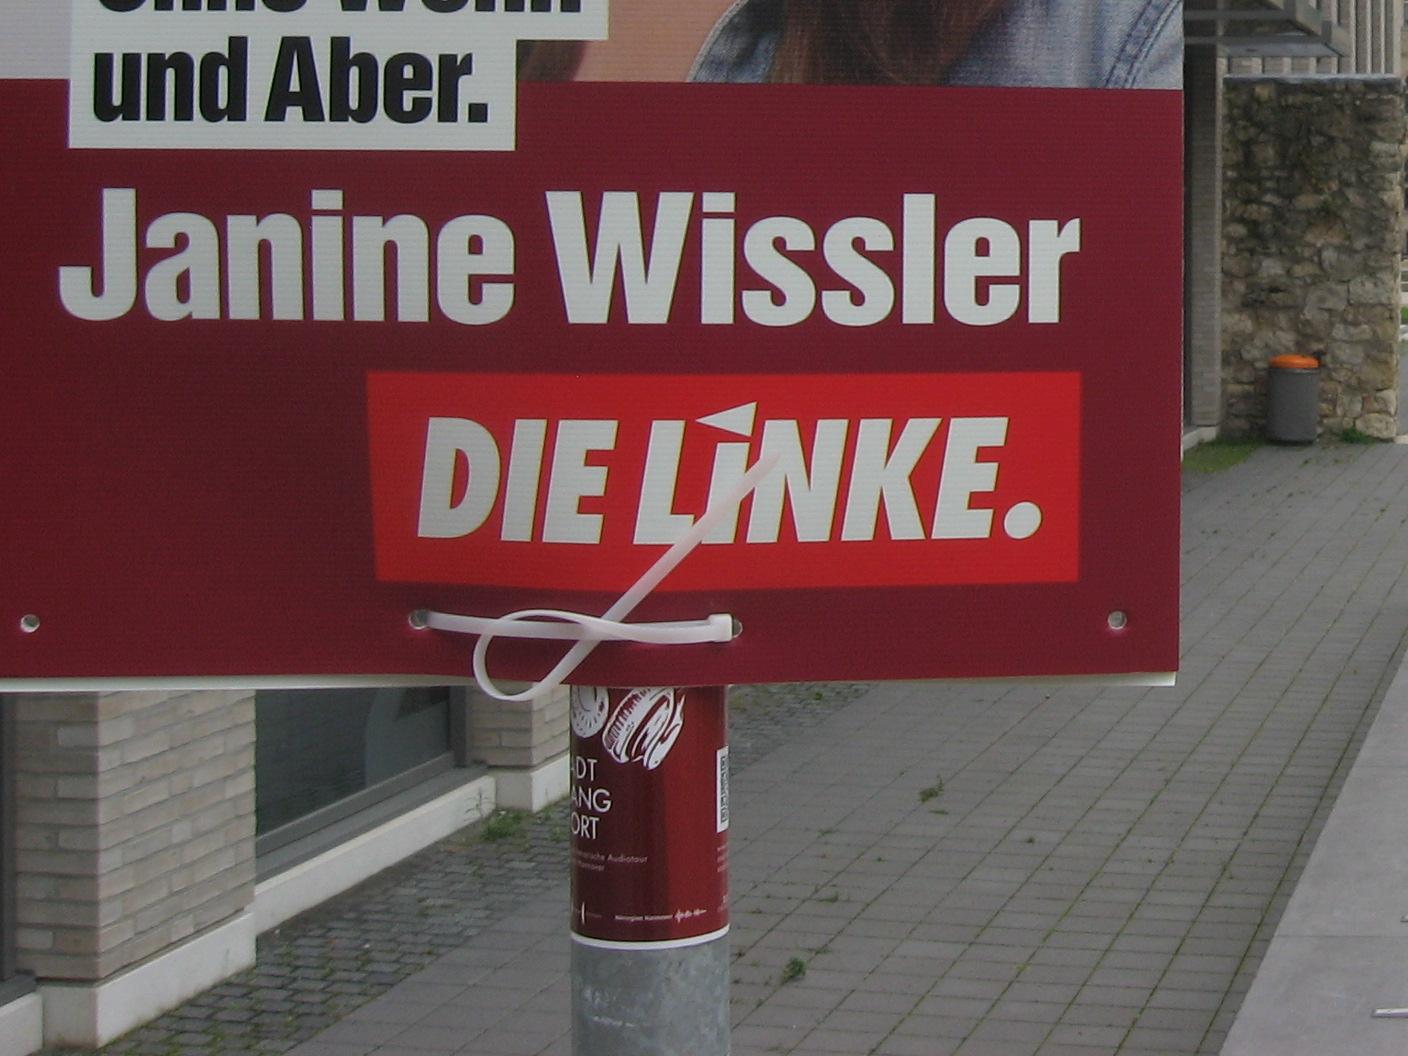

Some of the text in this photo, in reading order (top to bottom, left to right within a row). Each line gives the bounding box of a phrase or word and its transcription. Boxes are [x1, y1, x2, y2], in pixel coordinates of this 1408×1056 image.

[92, 35, 489, 124] und Aber.
[58, 187, 1082, 327] Janine Wissler
[417, 402, 1044, 546] DIE LINKE.
